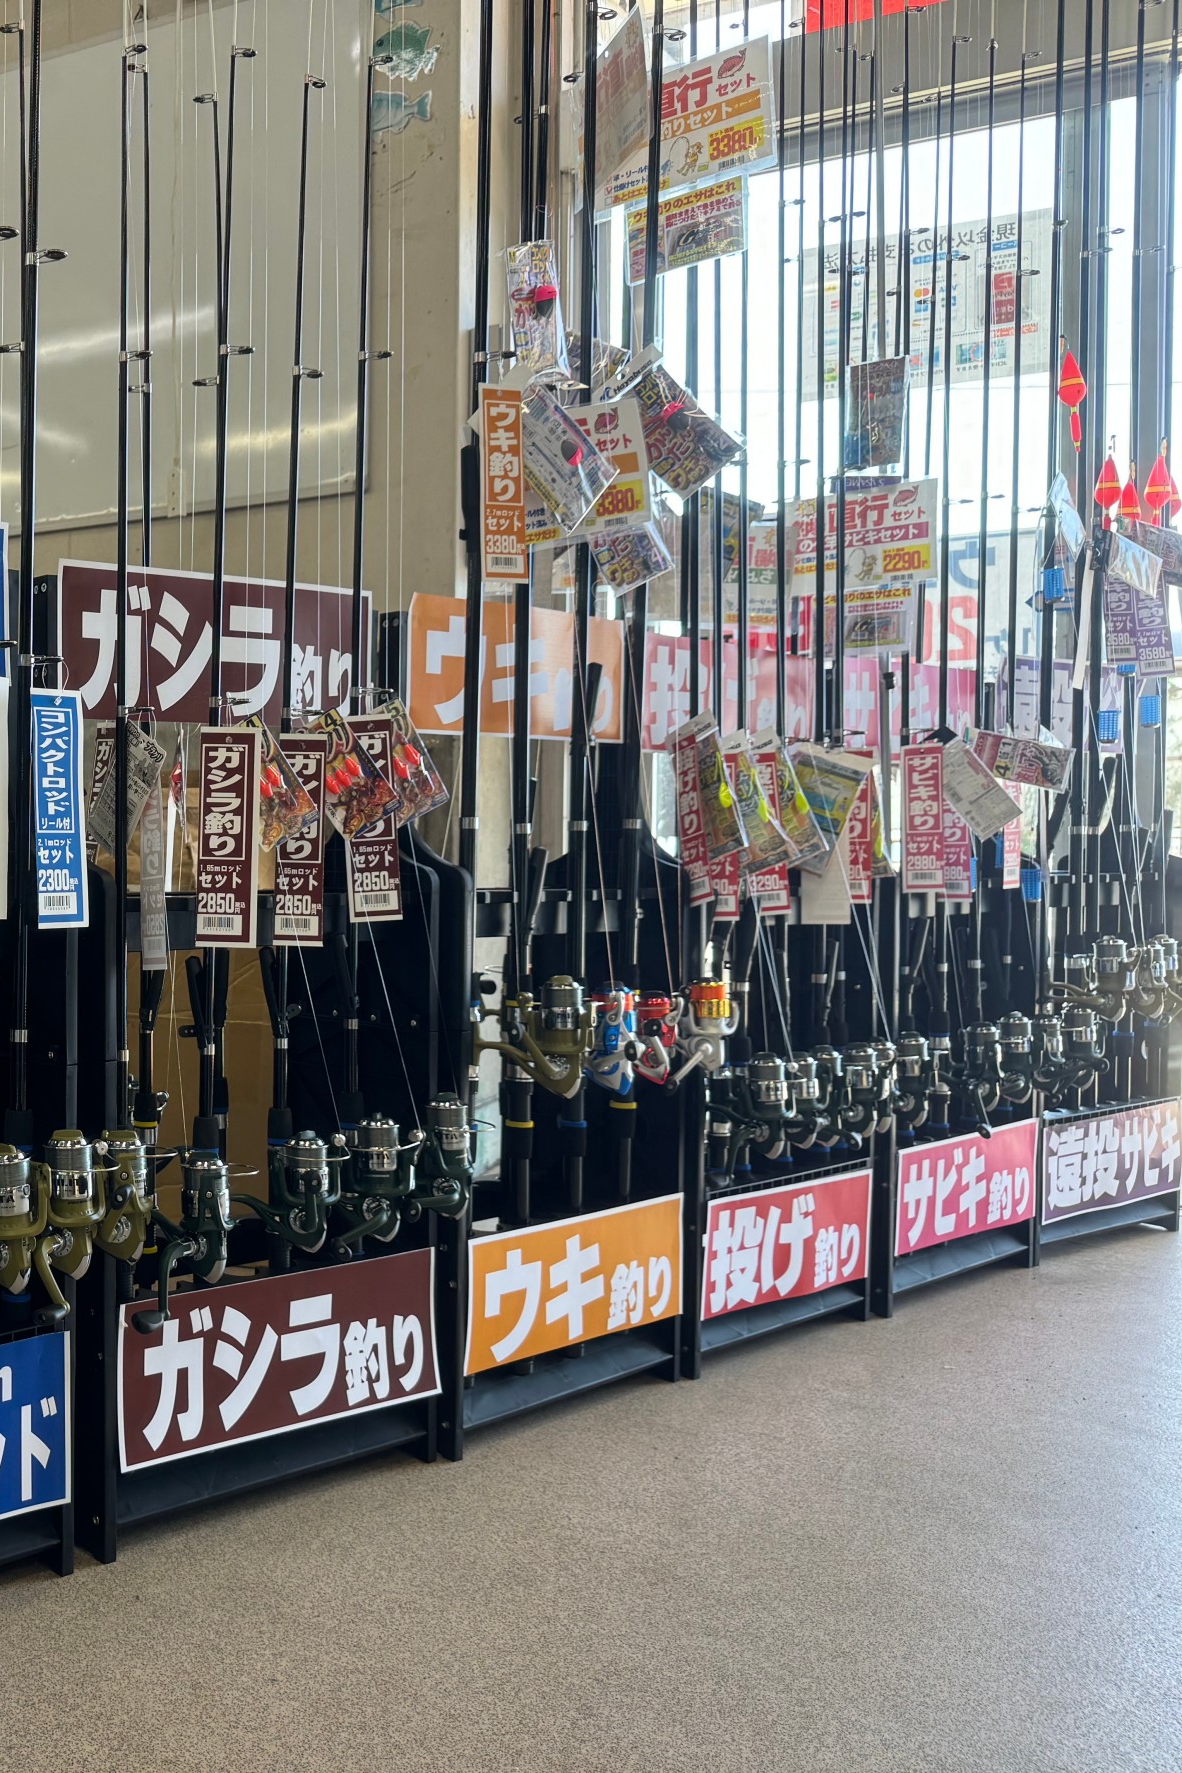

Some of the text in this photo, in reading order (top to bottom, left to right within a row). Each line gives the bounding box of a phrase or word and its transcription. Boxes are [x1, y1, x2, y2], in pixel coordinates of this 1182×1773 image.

[716, 72, 756, 96] セット
[709, 127, 754, 161] 3380
[613, 359, 653, 396] Hayabusa
[488, 404, 519, 501] ウキ釣り
[596, 433, 632, 451] セット
[486, 516, 522, 531] セット
[890, 507, 925, 521] セット
[486, 534, 517, 554] 3380
[883, 551, 922, 573] 2290
[1138, 635, 1168, 647] セット
[80, 585, 353, 719] ガシラ釣り
[40, 711, 70, 816] コンパクトロッド
[205, 746, 245, 857] ガシラ釣り
[908, 756, 939, 831] サビキ釣り
[41, 817, 71, 829] リール付
[37, 846, 74, 865] セット
[907, 842, 941, 854] セット
[353, 852, 394, 868] セット
[907, 855, 936, 871] 2980
[38, 870, 69, 891] 2300
[199, 872, 242, 889] セット
[276, 875, 319, 890] セット
[354, 871, 389, 891] 2850
[749, 875, 779, 891] 3290
[198, 892, 235, 914] 2850
[276, 895, 311, 914] 2850
[1047, 1112, 1180, 1210] 遠投サビキ
[903, 1146, 1030, 1247] サビキ釣り
[703, 1194, 860, 1314] 投げ釣り
[485, 1234, 672, 1362] ウキ釣り
[142, 1293, 424, 1452] ガシラ釣り
